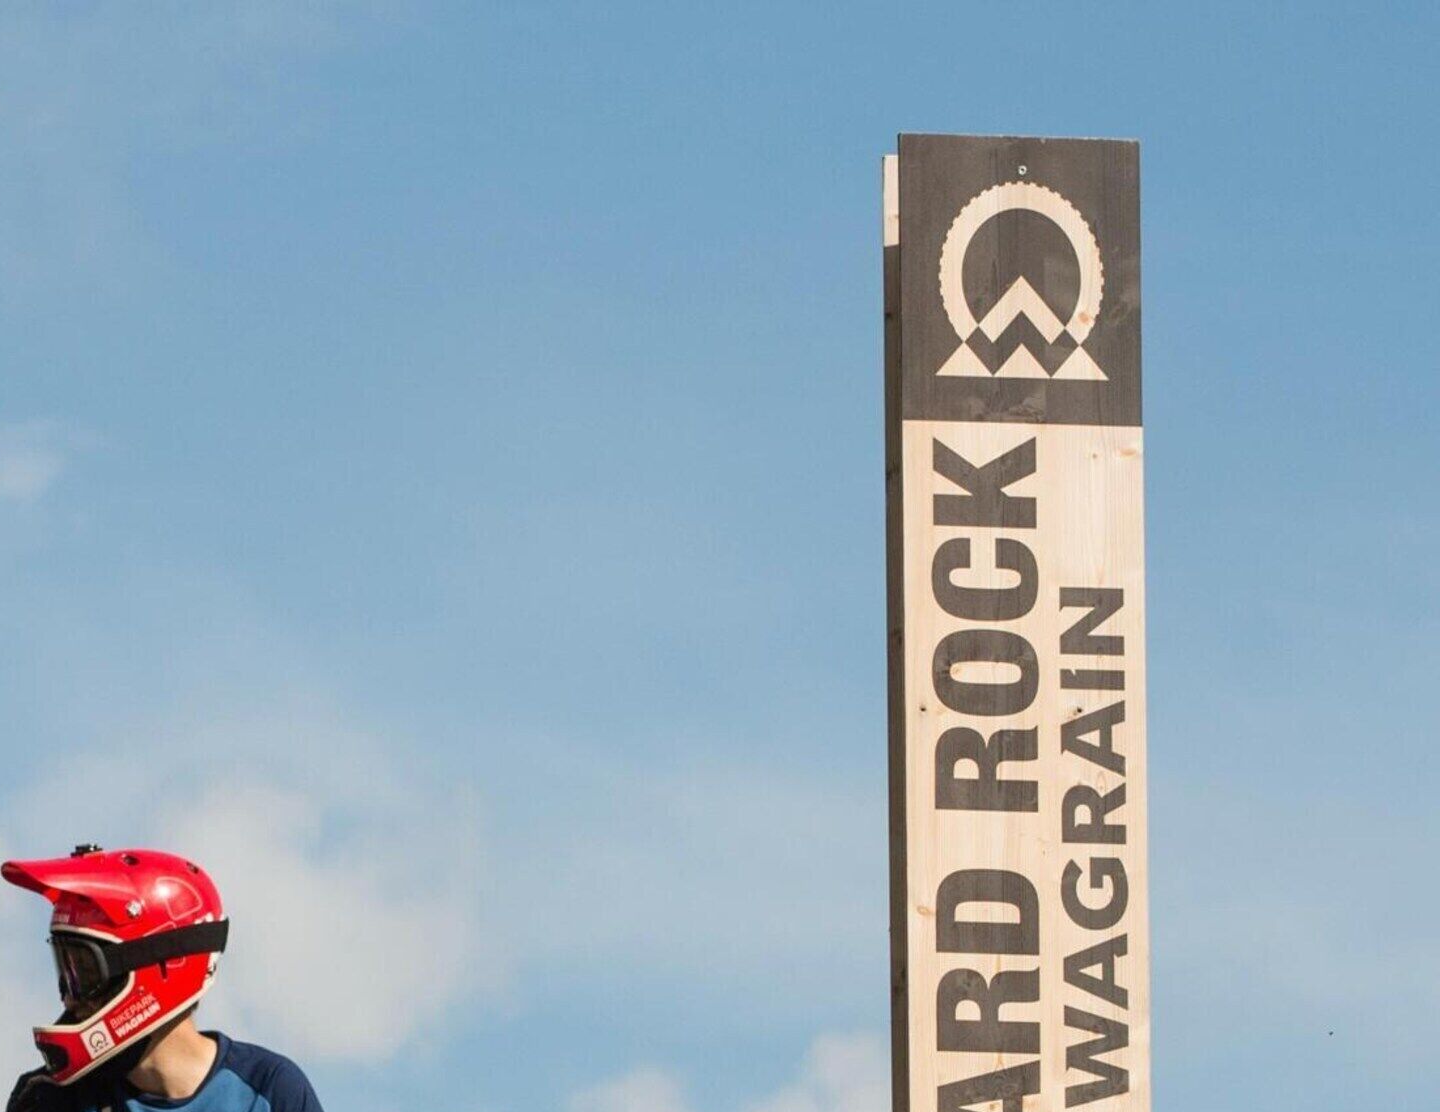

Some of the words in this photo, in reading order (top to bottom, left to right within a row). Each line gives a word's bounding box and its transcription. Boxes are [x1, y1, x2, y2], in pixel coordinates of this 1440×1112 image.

[931, 436, 1040, 813] ROCK
[1059, 586, 1130, 1108] WAGRAIN
[109, 993, 158, 1030] BIKEPARK
[115, 1002, 162, 1038] WAGRAIN
